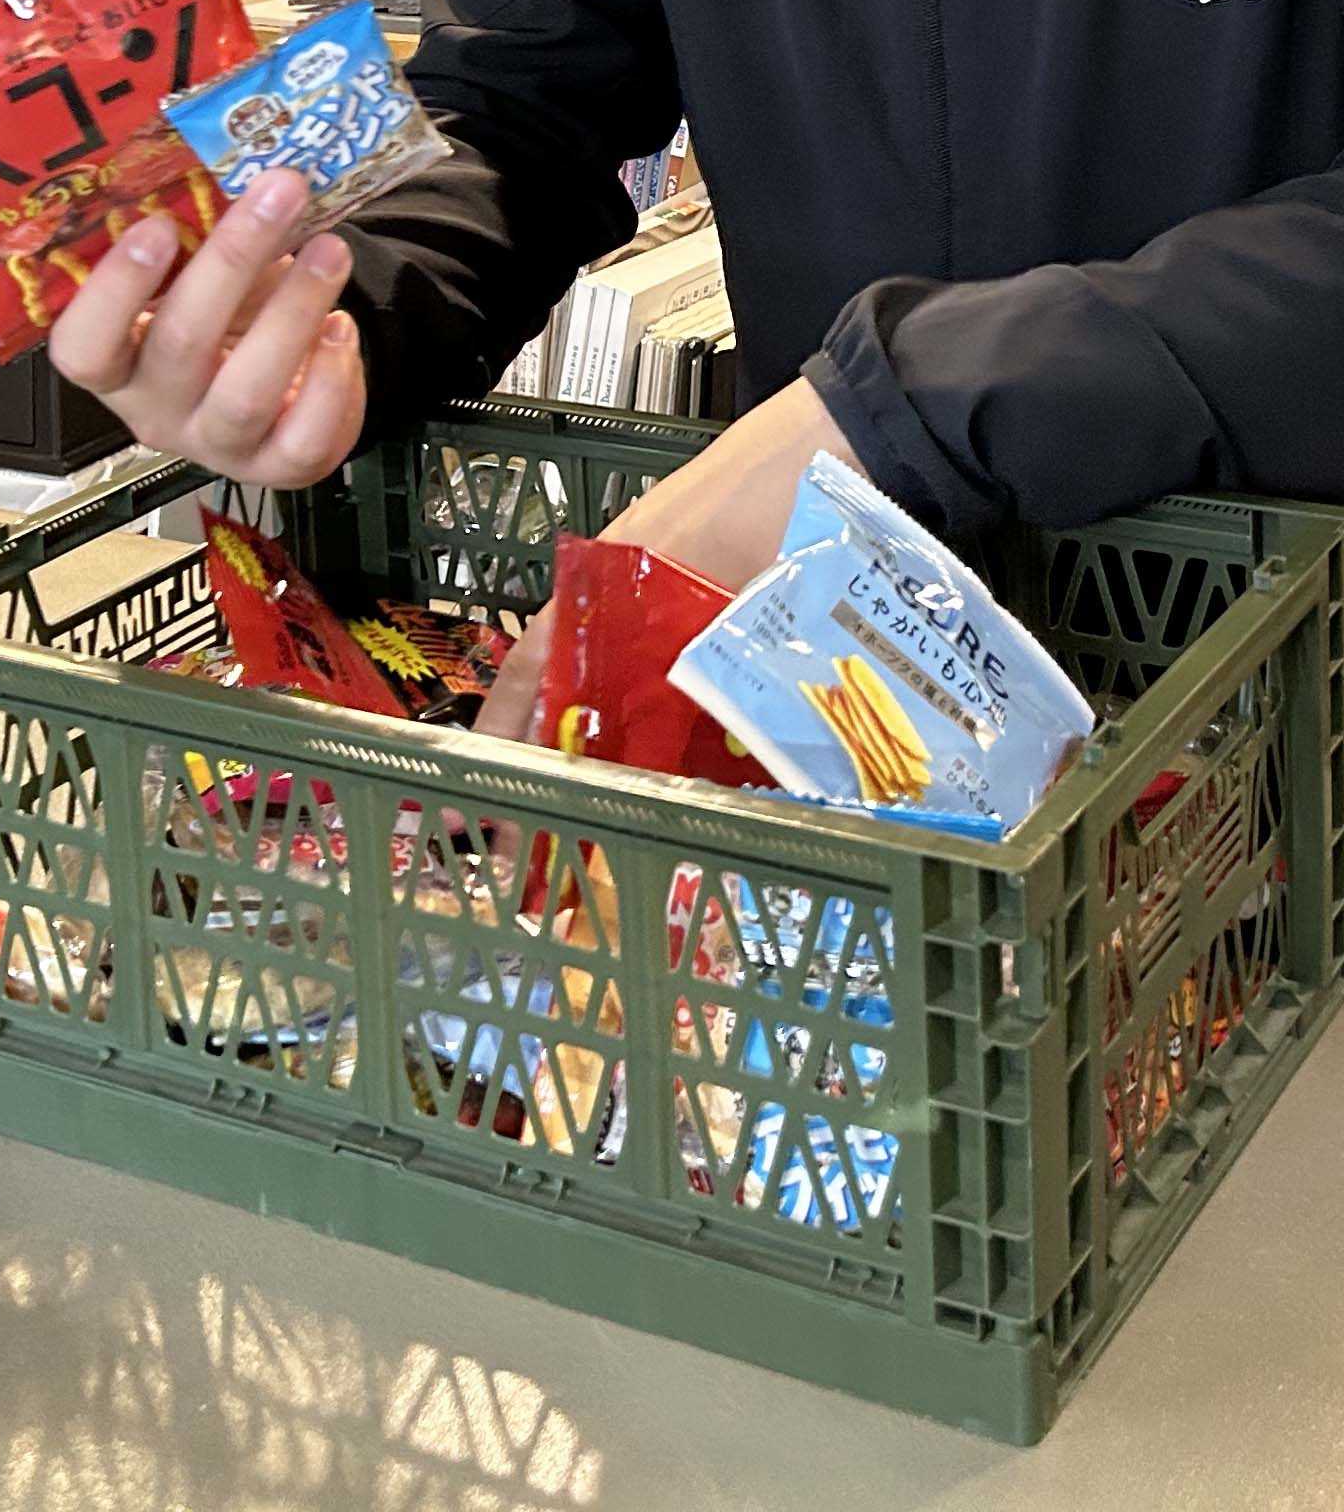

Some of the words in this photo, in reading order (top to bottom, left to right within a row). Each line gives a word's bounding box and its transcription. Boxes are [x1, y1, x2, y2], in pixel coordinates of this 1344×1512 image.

[848, 573, 1006, 735] じゃがいも心地
